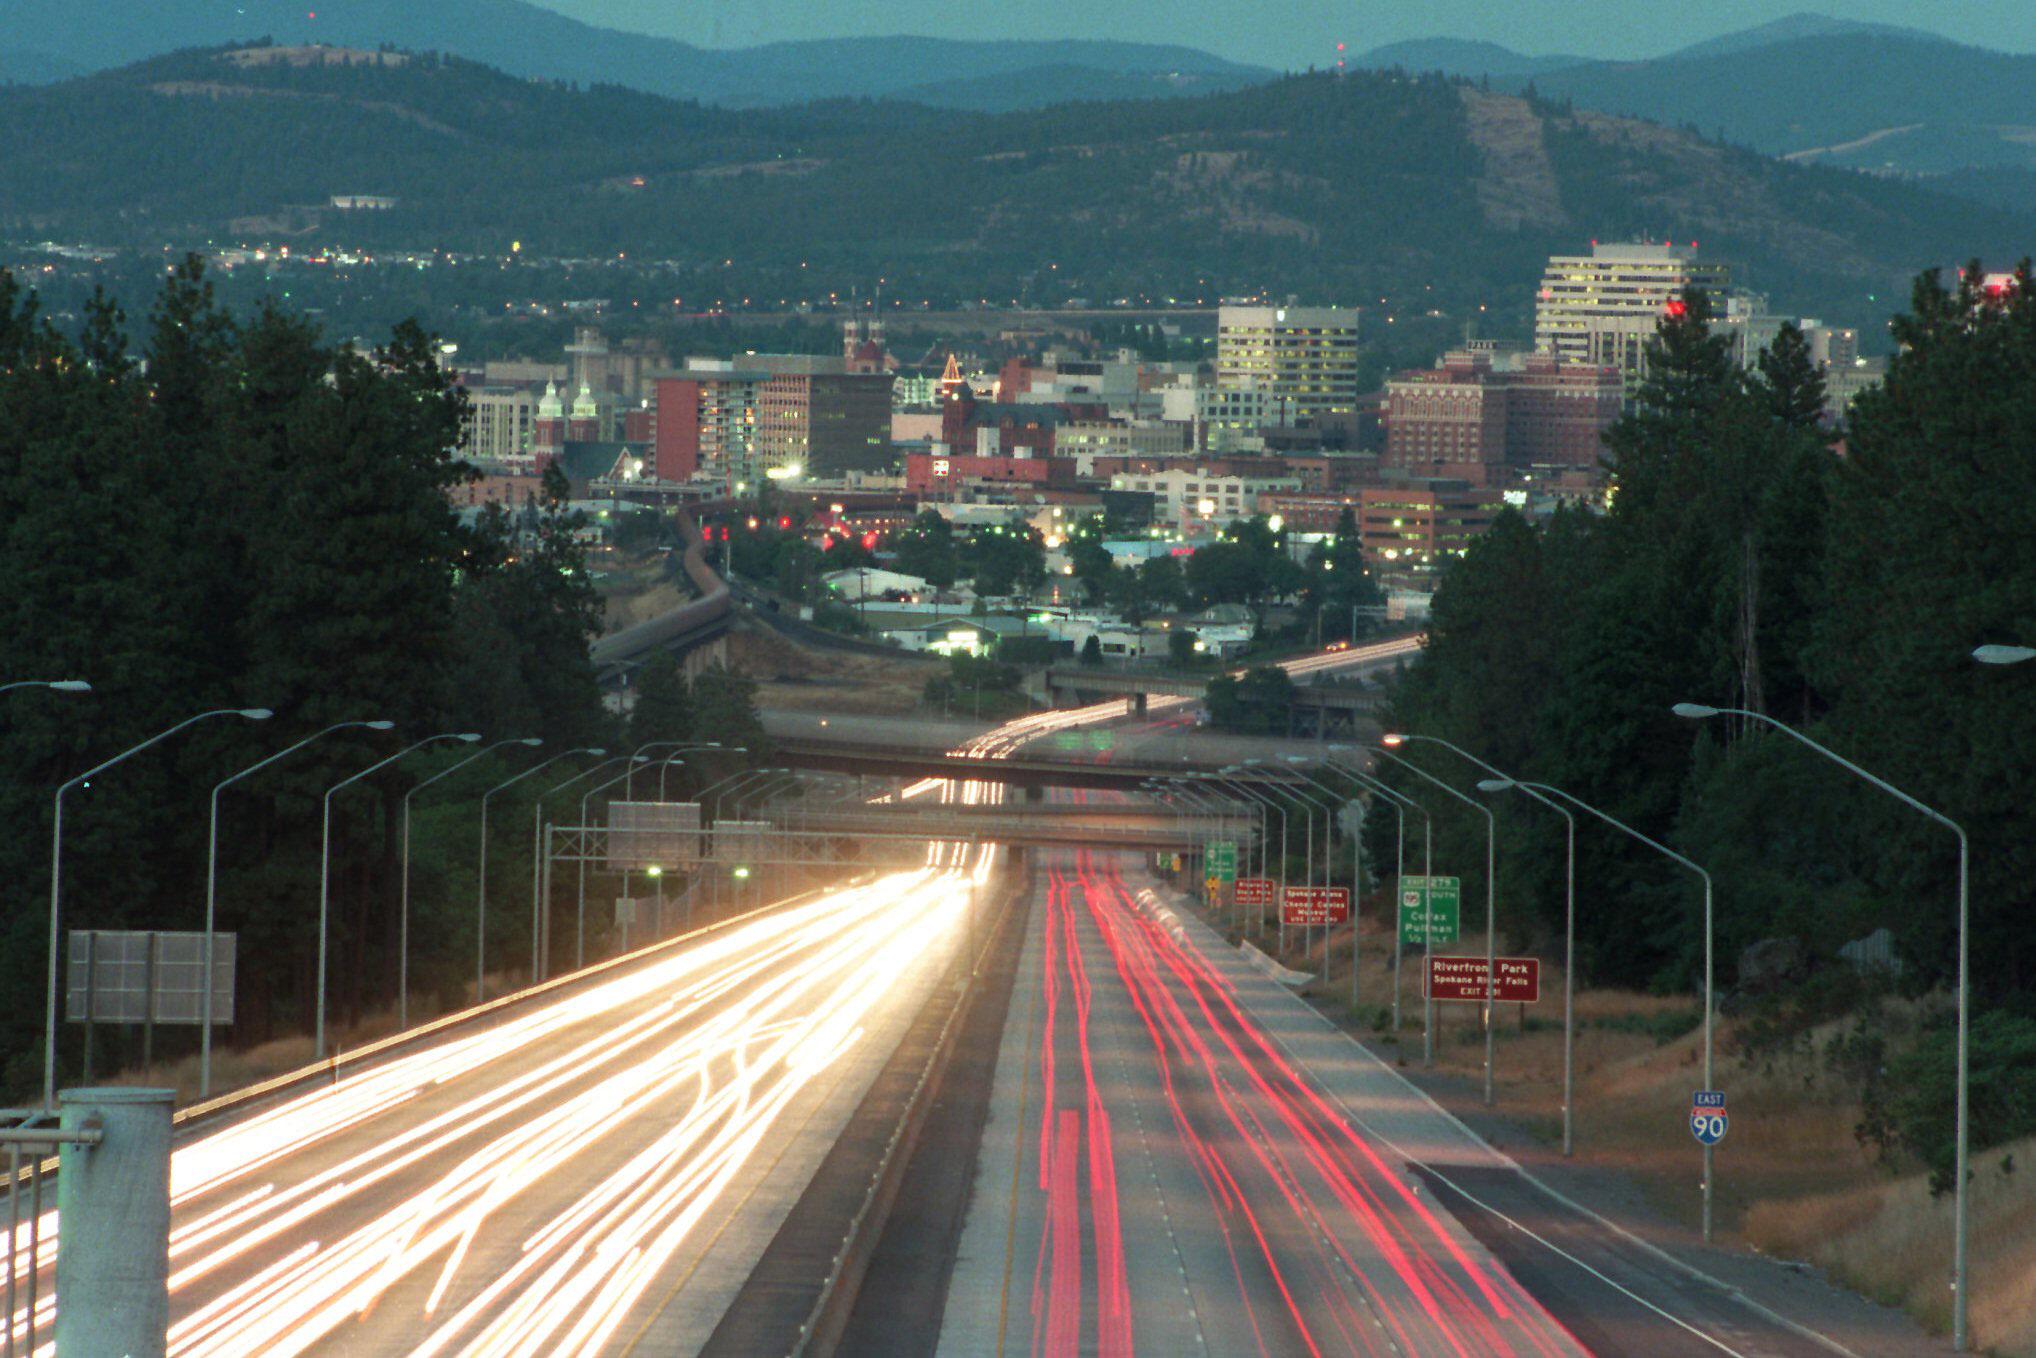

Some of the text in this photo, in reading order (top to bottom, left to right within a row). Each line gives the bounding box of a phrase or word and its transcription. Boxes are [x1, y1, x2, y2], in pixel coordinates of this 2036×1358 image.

[1411, 911, 1447, 921] Coax
[1405, 923, 1452, 933] Pulman
[1433, 961, 1528, 974] Riverfron Park
[1433, 975, 1473, 985] Spokane
[1506, 977, 1529, 986] Falls
[1460, 987, 1481, 995] EXIT
[1698, 1094, 1721, 1105] EAST
[1694, 1116, 1724, 1138] 90
